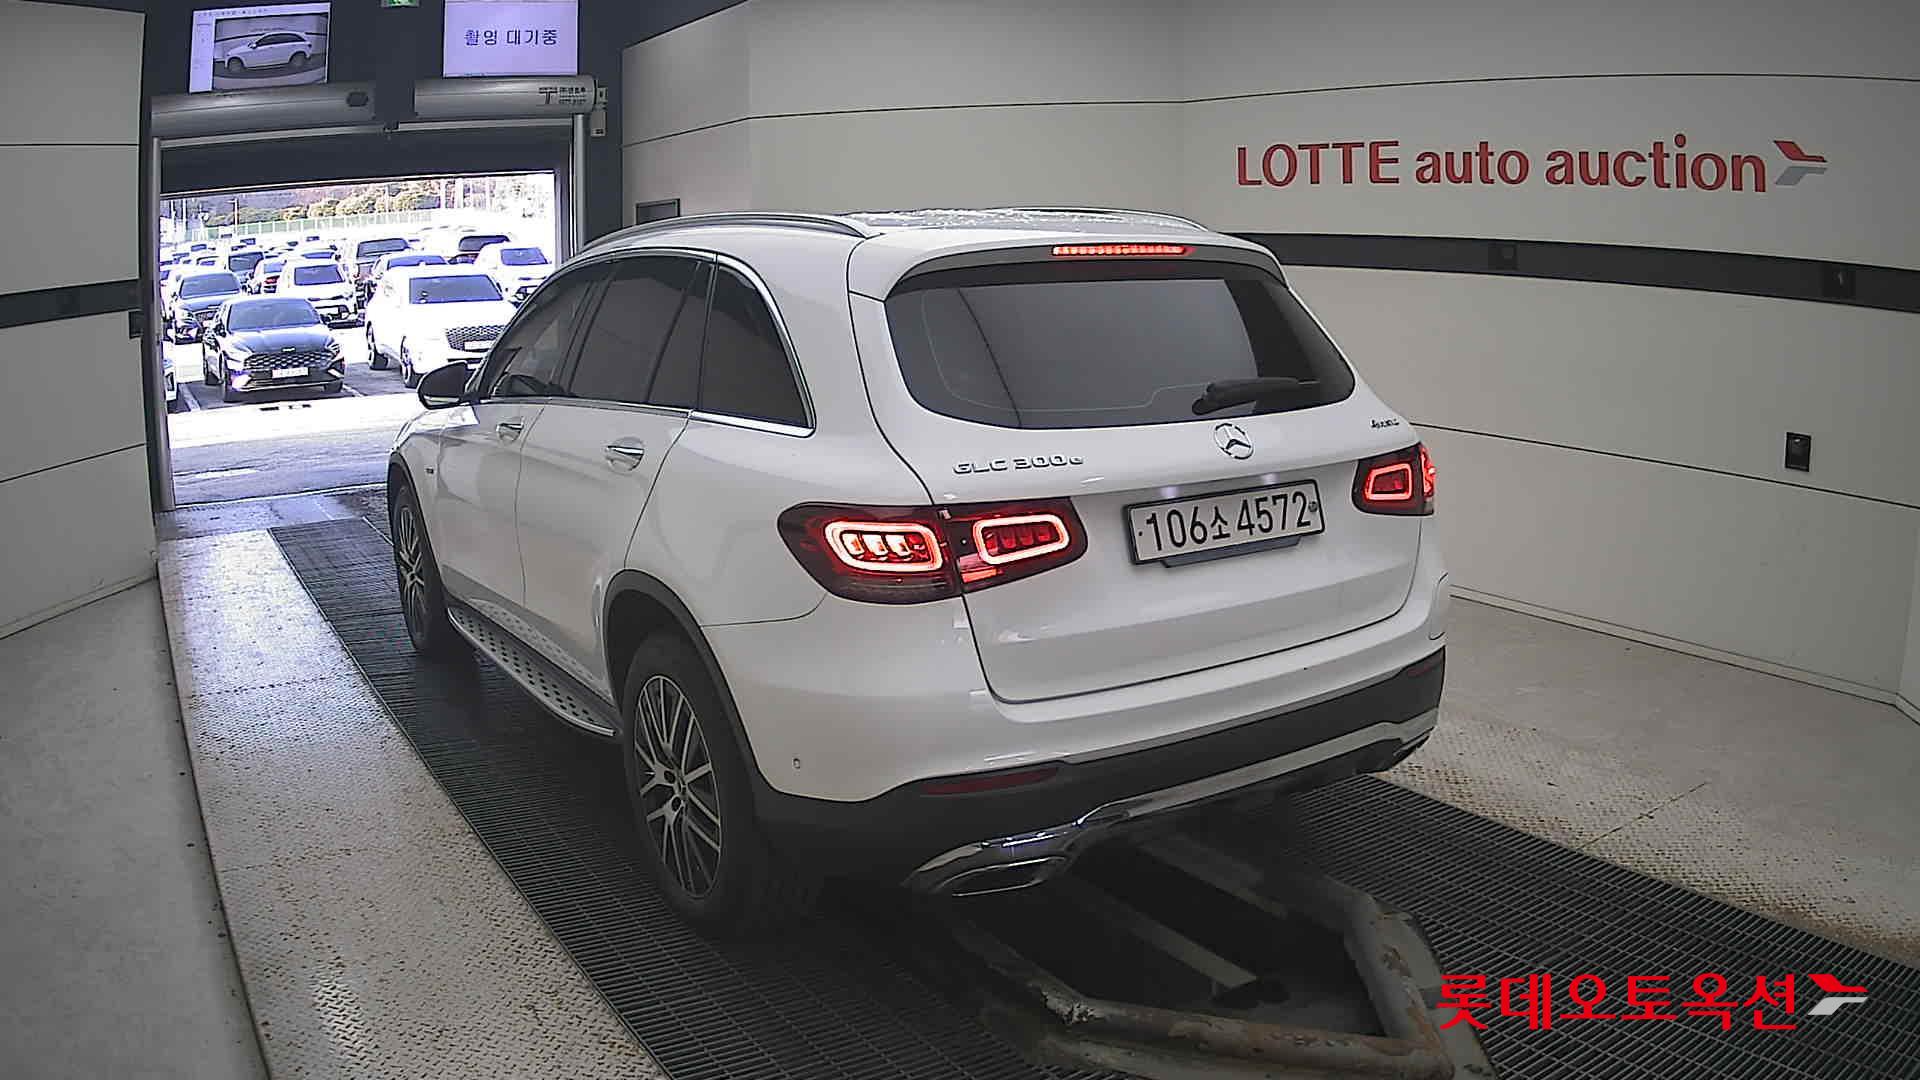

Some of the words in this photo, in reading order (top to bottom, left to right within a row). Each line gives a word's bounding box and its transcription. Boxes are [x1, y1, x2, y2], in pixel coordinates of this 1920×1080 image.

[506, 29, 558, 46] 대기중
[1237, 140, 1400, 187] LOTTE
[1415, 141, 1530, 185] auto
[1545, 133, 1767, 193] auction
[952, 459, 1008, 475] GLC
[1012, 454, 1084, 470] 300e
[1237, 491, 1312, 536] 4572
